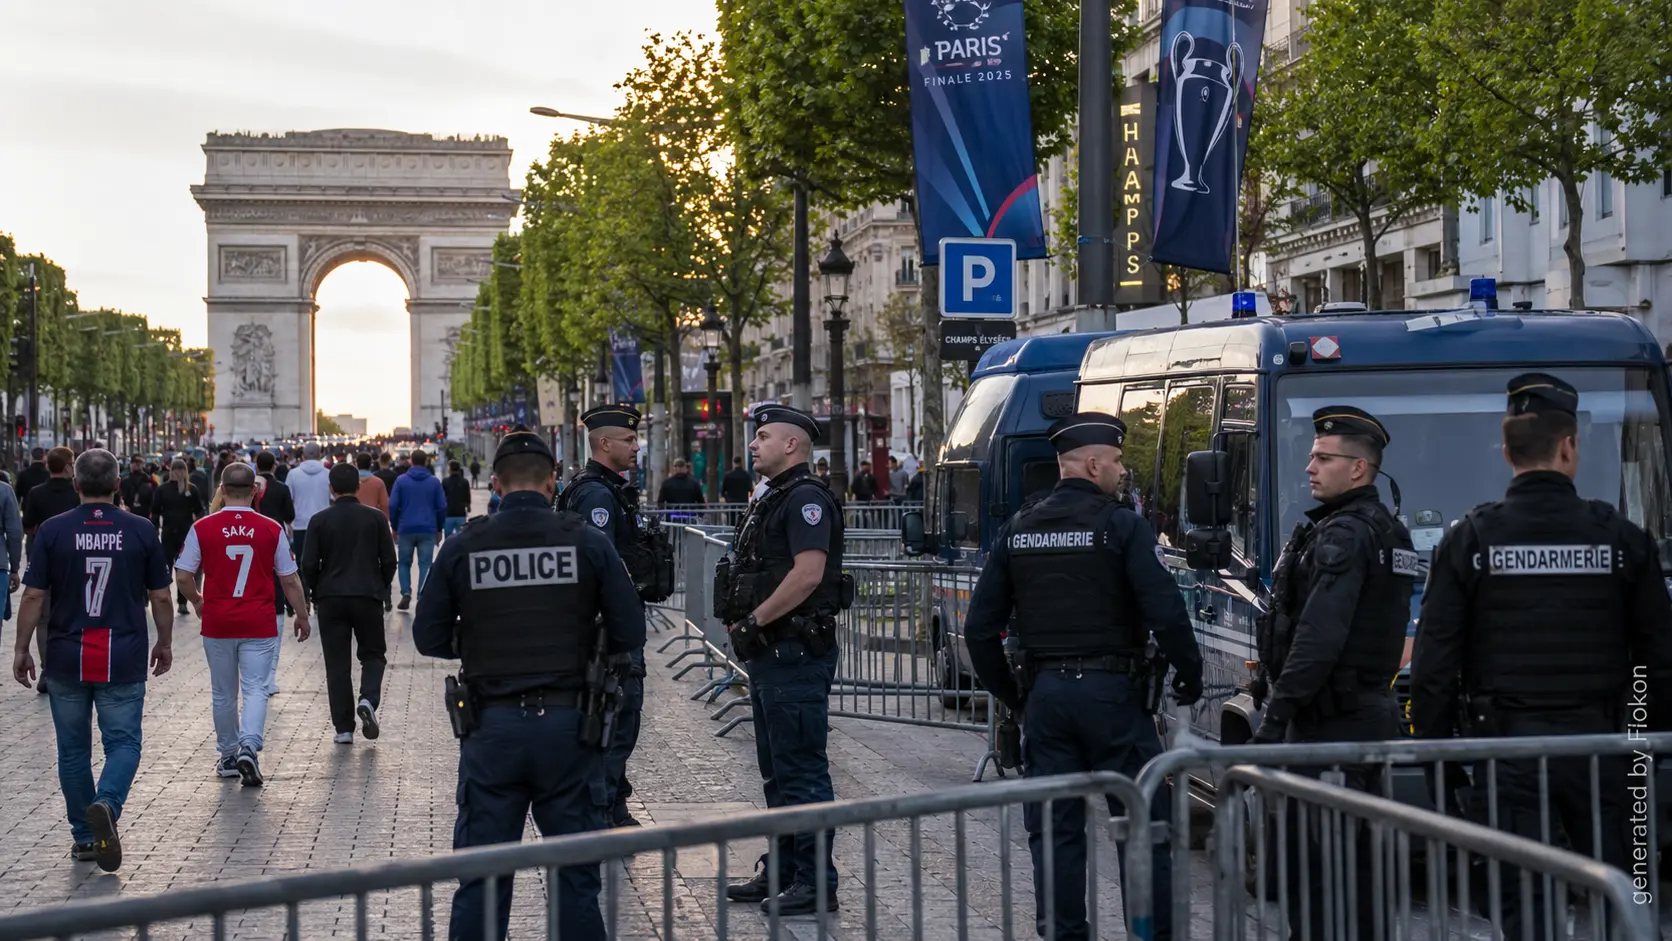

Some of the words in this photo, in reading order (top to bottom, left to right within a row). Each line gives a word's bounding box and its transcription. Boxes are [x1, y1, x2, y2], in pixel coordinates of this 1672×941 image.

[935, 36, 1002, 60] PARIS
[924, 73, 972, 87] FINALE
[978, 70, 1012, 82] 2025
[962, 255, 996, 302] P
[945, 336, 978, 344] CHAMPS
[75, 530, 123, 551] MBAPPÉ
[222, 525, 255, 539] SAKA
[1012, 531, 1094, 549] GENDARMERIE
[474, 551, 573, 584] POLICE
[1492, 549, 1610, 570] GENDARMERIE
[225, 545, 254, 598] 7
[85, 557, 112, 617] 7
